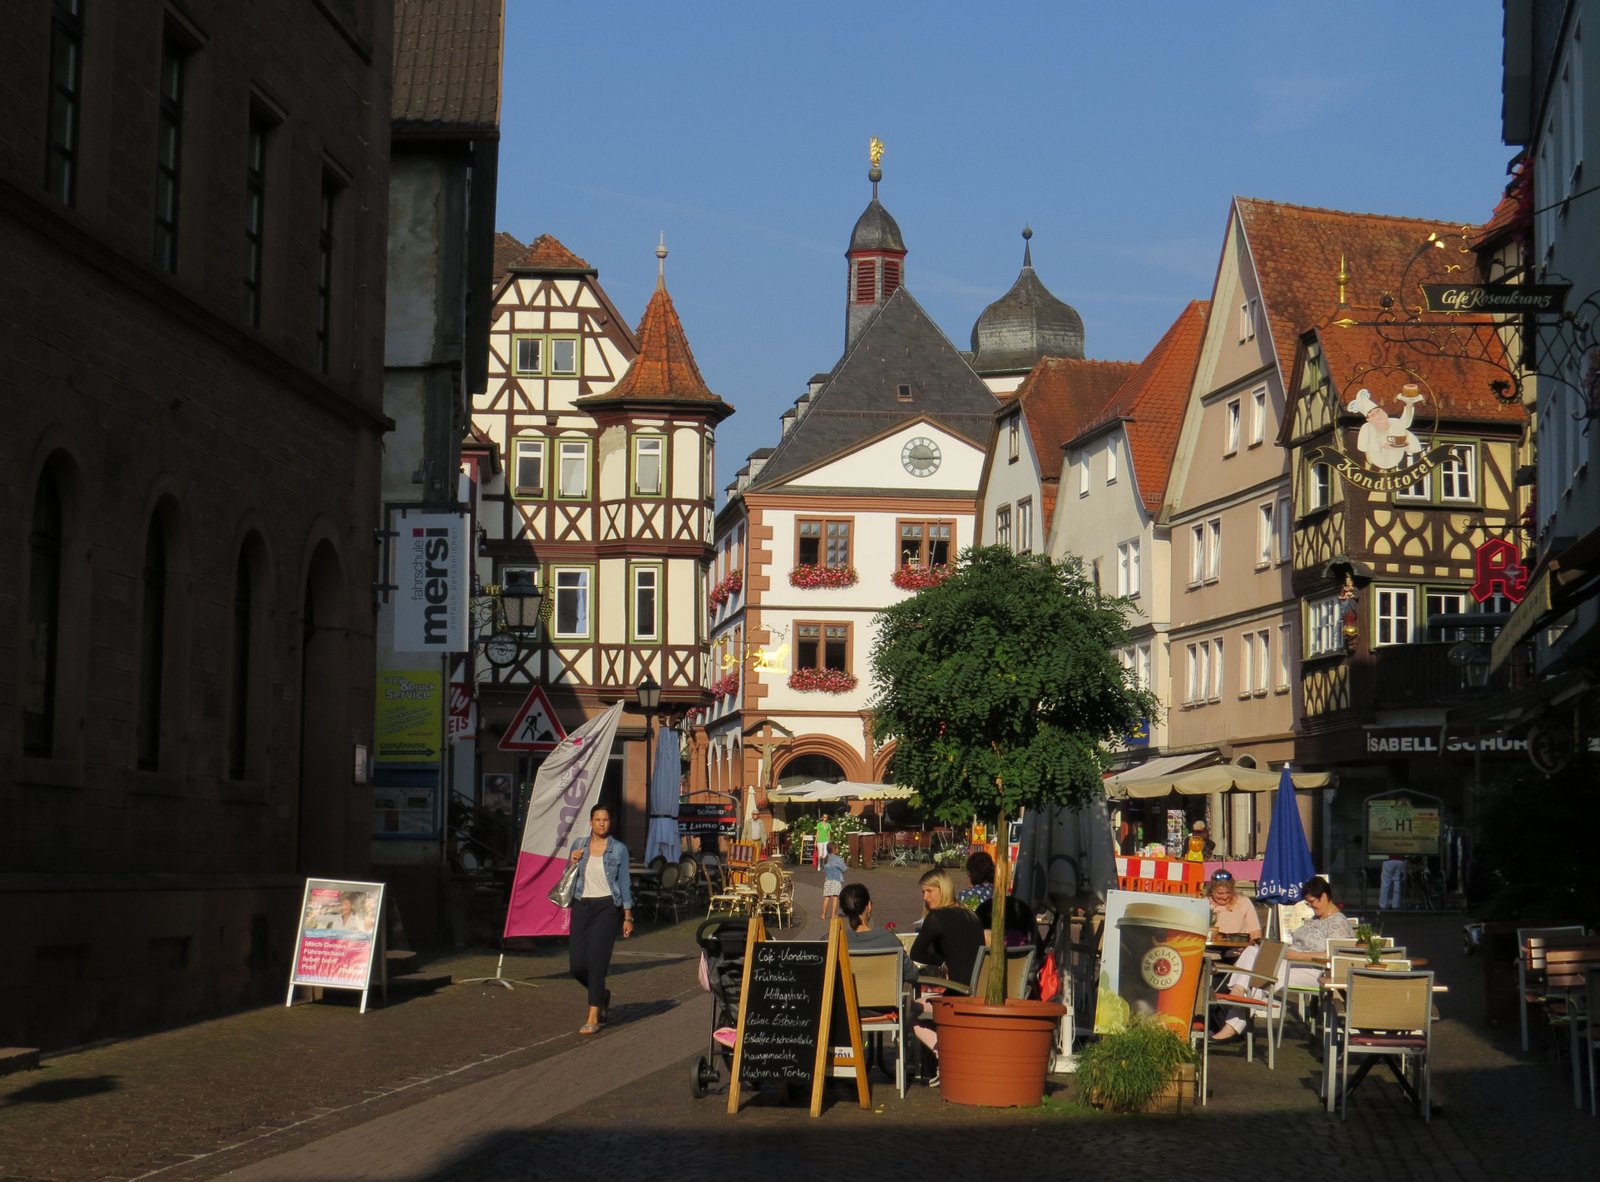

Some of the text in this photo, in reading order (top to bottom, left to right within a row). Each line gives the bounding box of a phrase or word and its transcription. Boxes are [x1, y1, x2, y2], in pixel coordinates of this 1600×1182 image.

[1441, 287, 1552, 309] Café Rosenkranz
[1336, 455, 1435, 491] Konditorei
[411, 540, 424, 601] fahrschule
[424, 527, 449, 645] mersi
[386, 689, 432, 700] Service
[1366, 732, 1438, 752] ISABELL
[303, 948, 345, 957] Führerschein
[304, 940, 323, 948] Mach
[758, 947, 776, 965] Café
[1149, 974, 1173, 987] TO GO
[763, 986, 810, 1008] Mittagstisch
[771, 1013, 811, 1027] Eisbecher
[743, 1049, 799, 1065] hausgemachte
[742, 1065, 772, 1079] Kuchen
[781, 1065, 811, 1079] Torten
